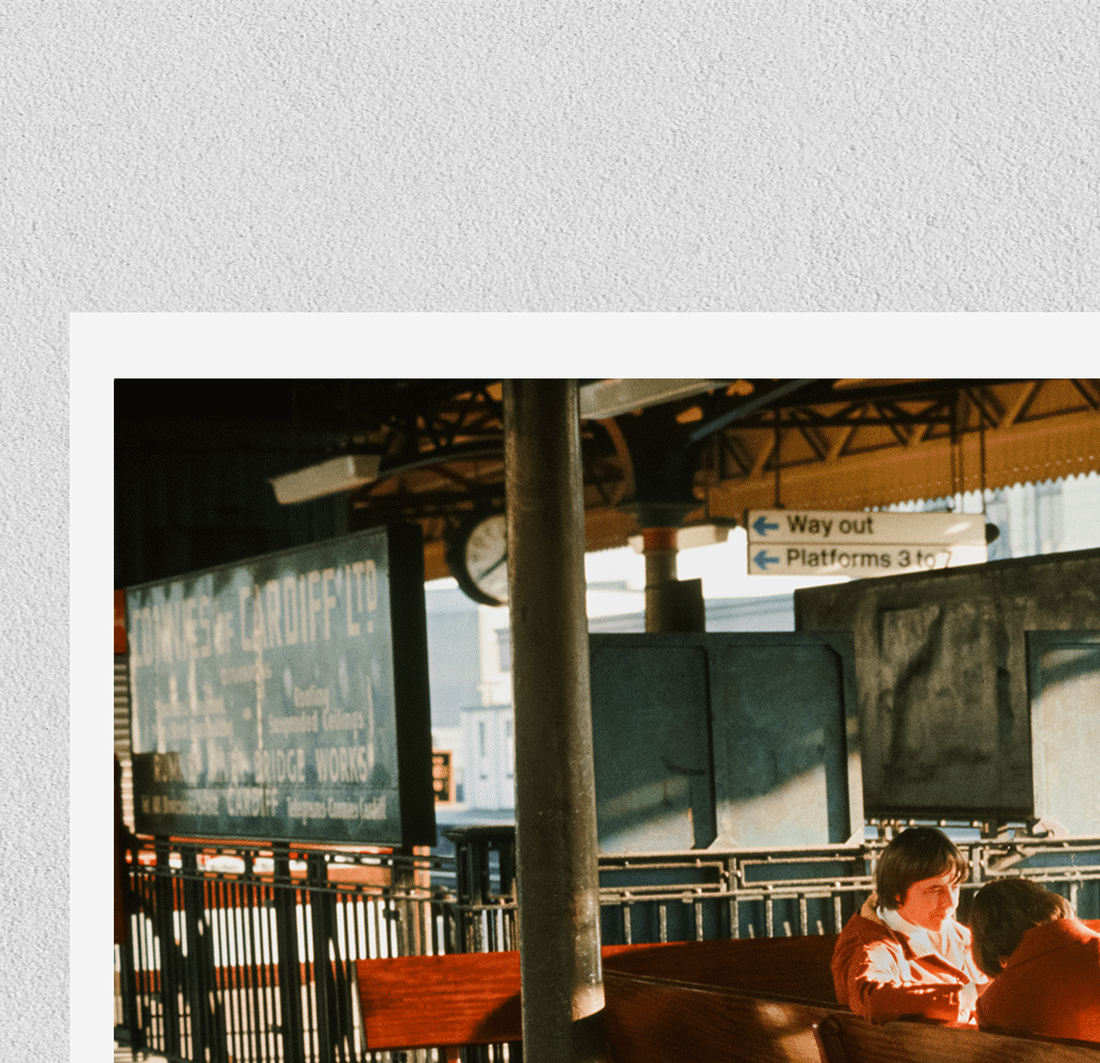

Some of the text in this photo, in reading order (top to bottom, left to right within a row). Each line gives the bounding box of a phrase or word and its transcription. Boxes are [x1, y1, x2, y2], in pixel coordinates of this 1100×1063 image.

[786, 515, 874, 538] Way out
[786, 548, 891, 569] Platforms
[898, 550, 912, 568] 3
[916, 551, 937, 570] to
[239, 567, 337, 653] CARDIFF
[254, 748, 305, 784] BRIDGE
[314, 746, 367, 784] WORKS
